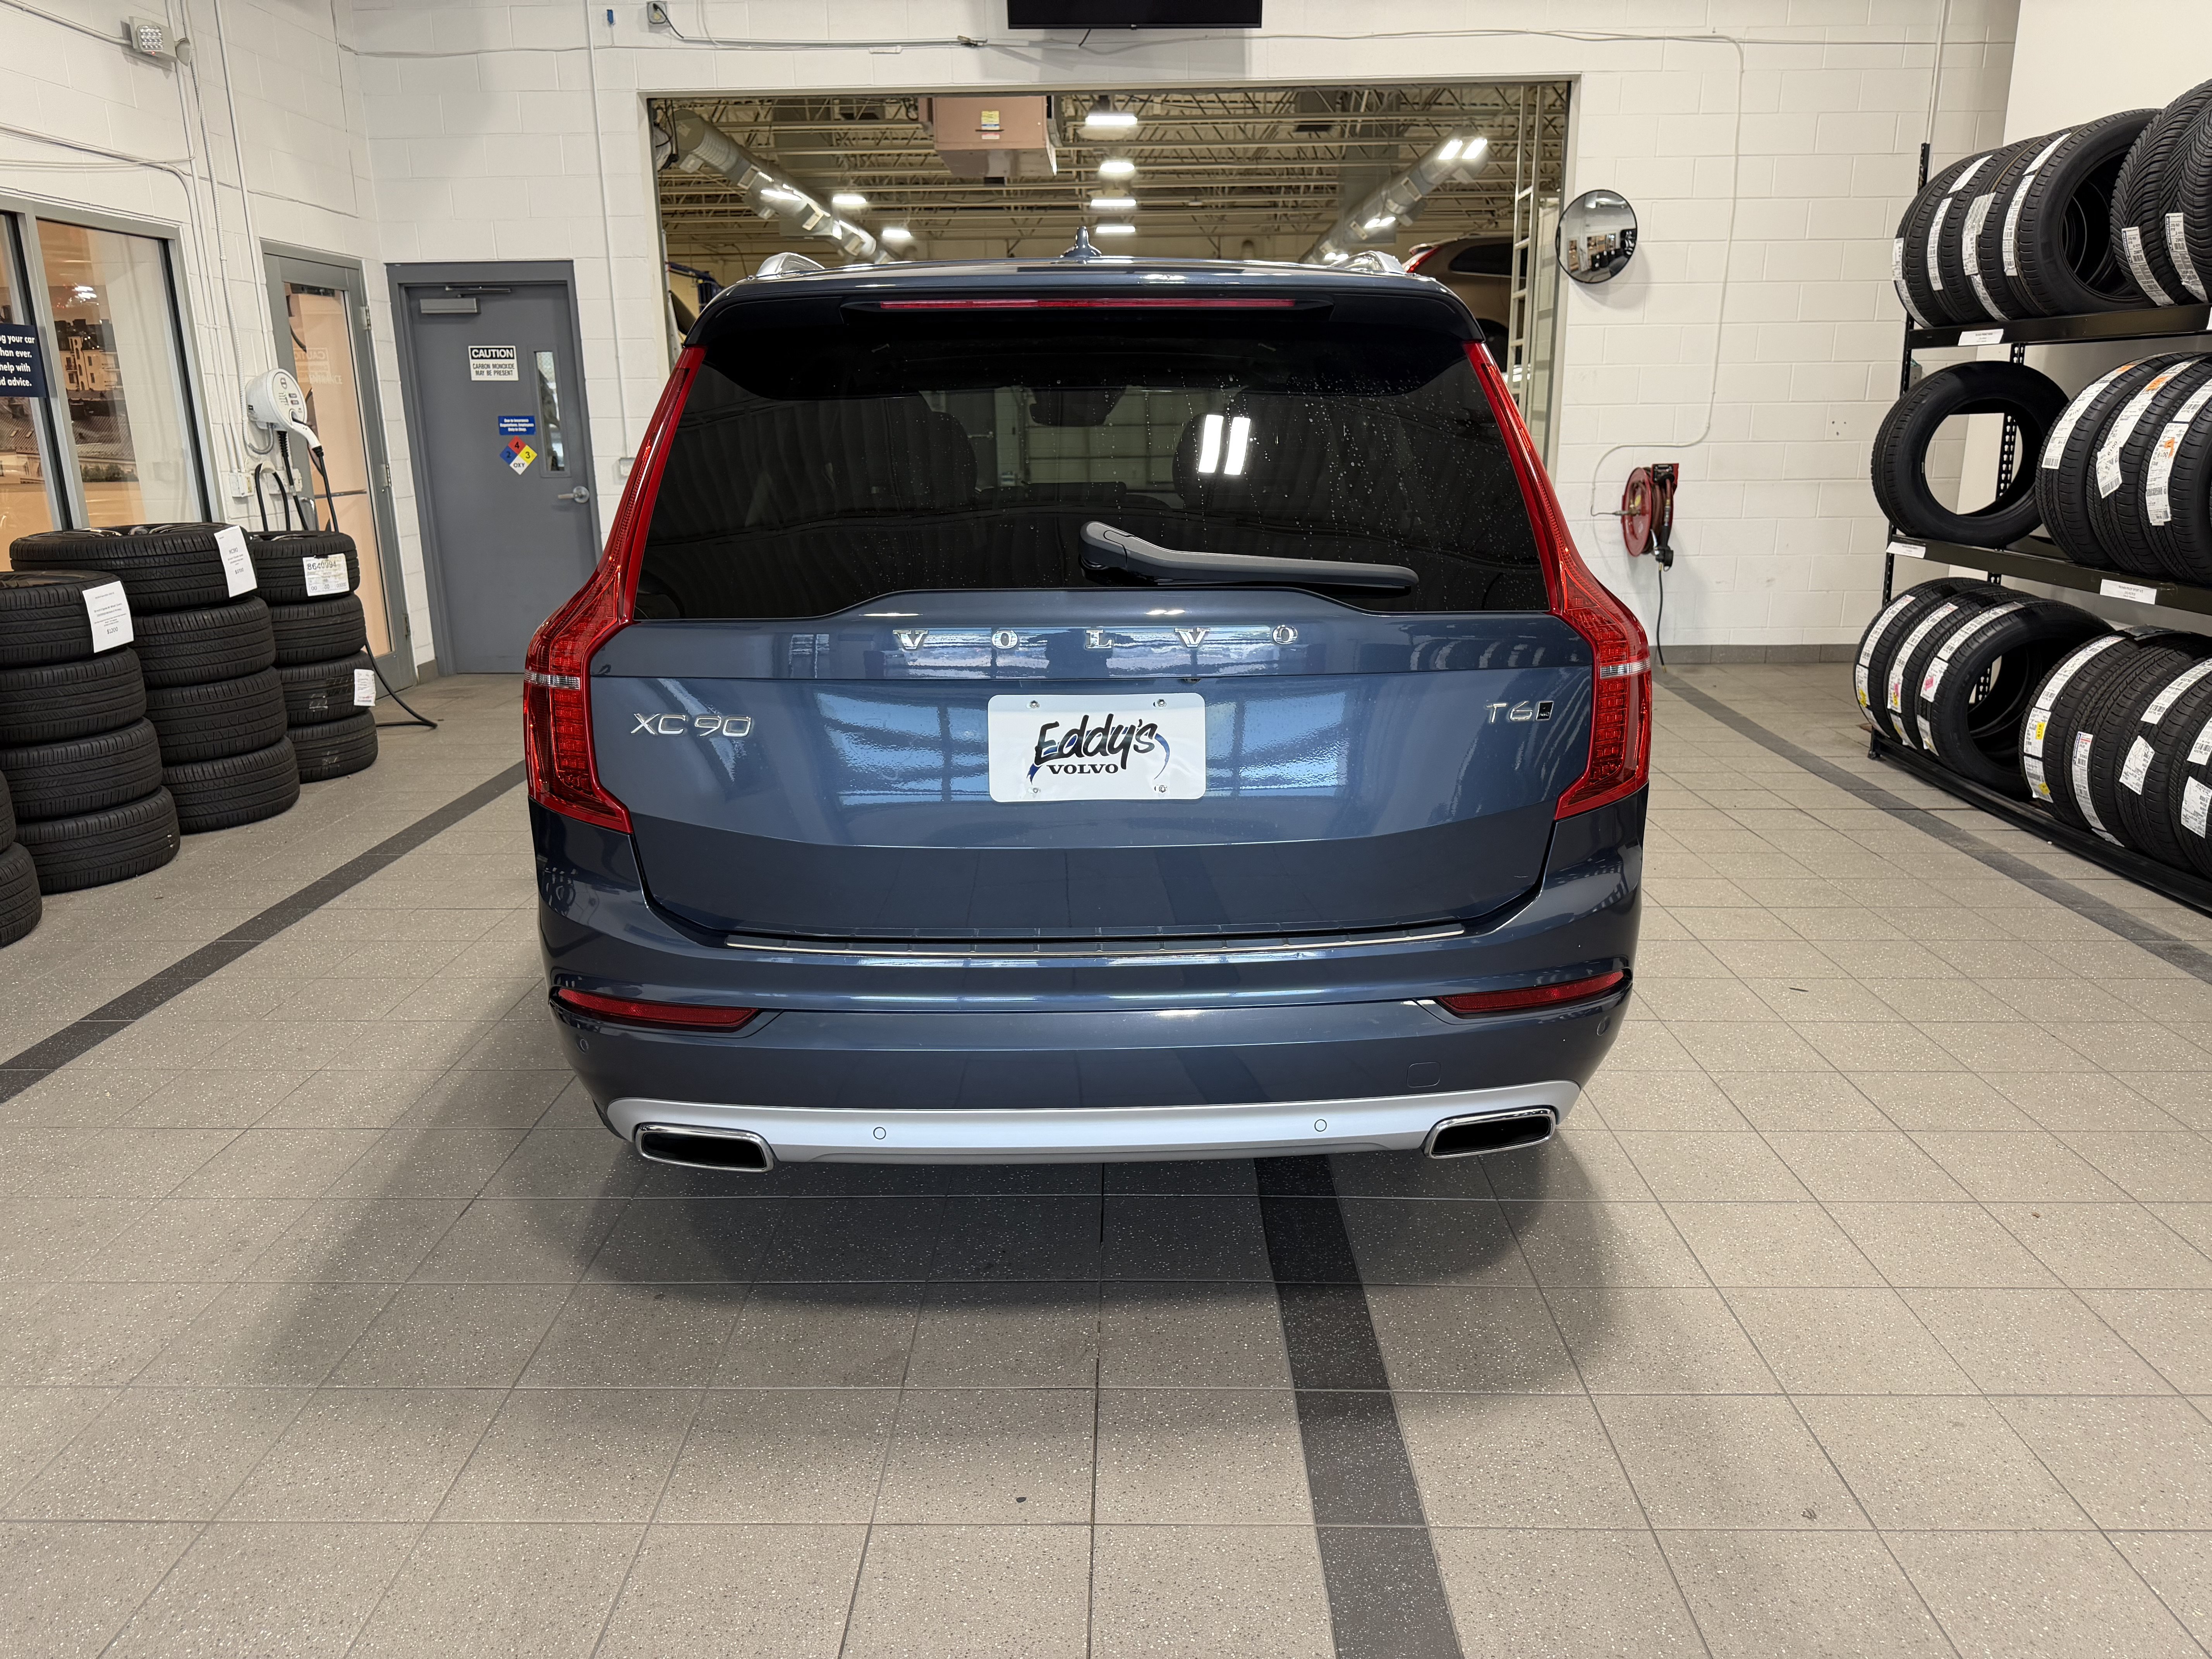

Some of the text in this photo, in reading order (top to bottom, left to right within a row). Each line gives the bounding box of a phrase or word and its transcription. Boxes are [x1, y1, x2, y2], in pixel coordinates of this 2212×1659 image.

[7, 335, 23, 344] your
[472, 349, 514, 358] CAUTION
[16, 362, 31, 372] with
[7, 377, 32, 386] advice.
[893, 624, 1298, 650] VOLVO
[1486, 700, 1533, 723] T6
[1034, 713, 1158, 770] Eddy's
[1046, 763, 1119, 775] VOLVO
